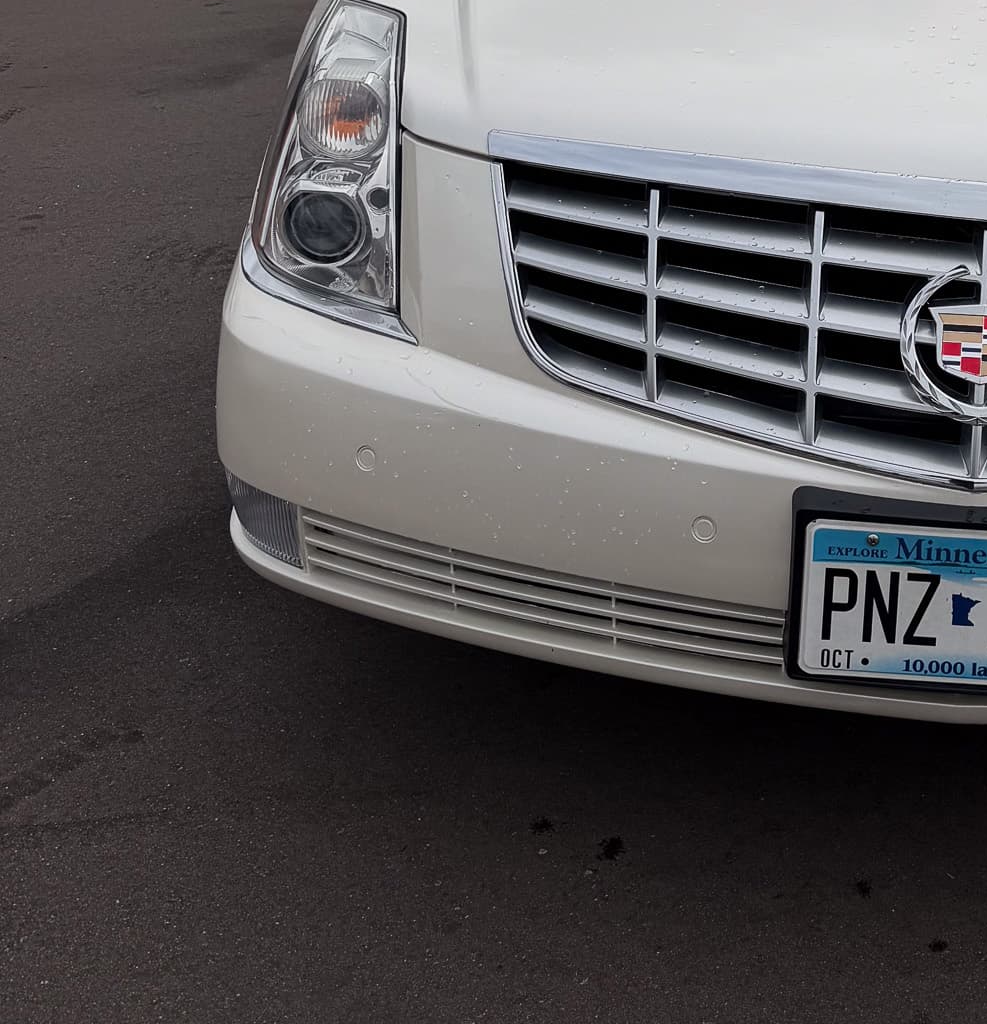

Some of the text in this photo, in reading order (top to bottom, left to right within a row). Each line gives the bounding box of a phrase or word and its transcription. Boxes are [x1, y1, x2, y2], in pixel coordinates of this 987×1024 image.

[828, 546, 888, 559] EXPLORE
[820, 567, 942, 647] PNZ
[820, 648, 854, 669] OCT
[903, 658, 965, 675] 10,000
